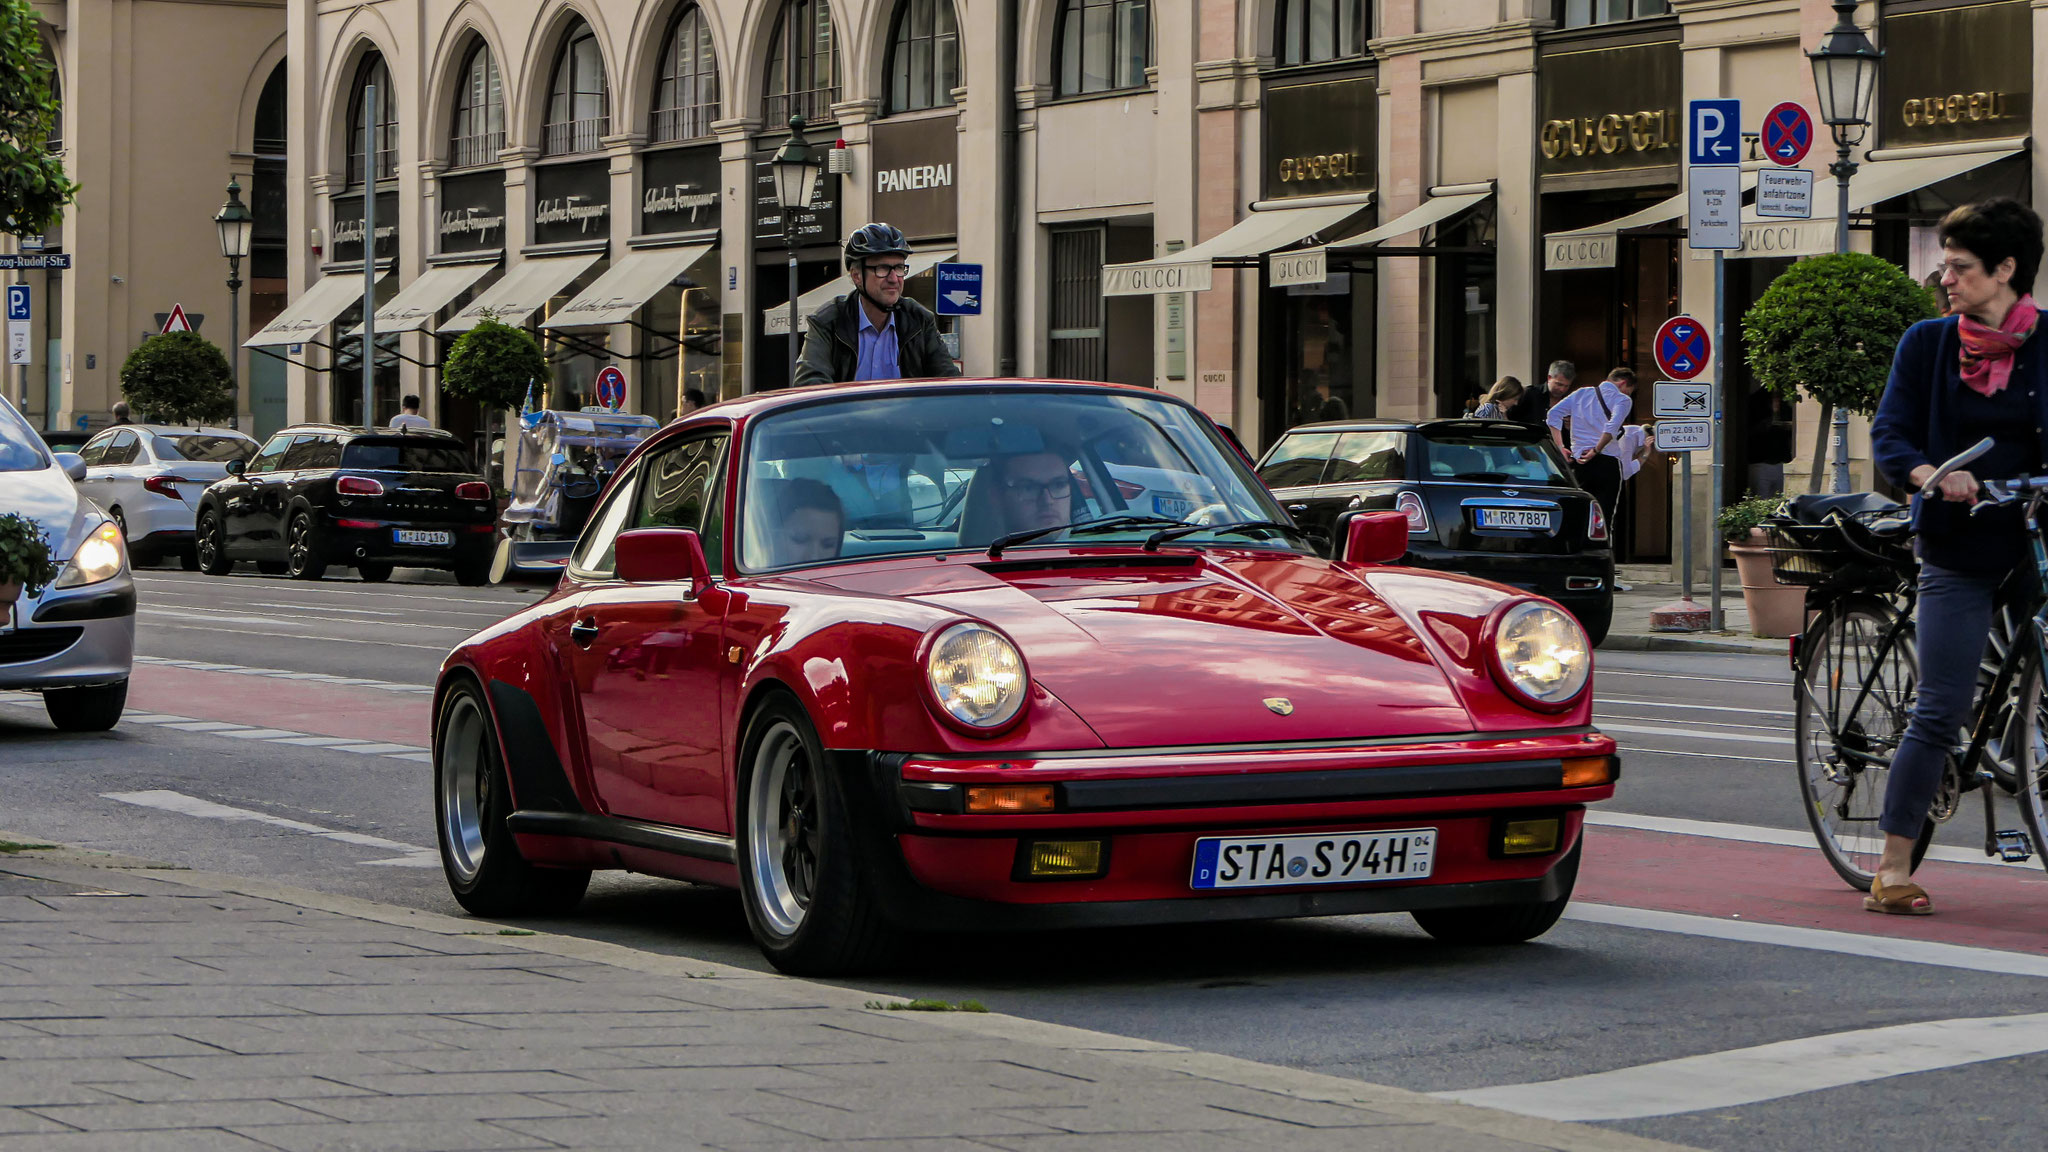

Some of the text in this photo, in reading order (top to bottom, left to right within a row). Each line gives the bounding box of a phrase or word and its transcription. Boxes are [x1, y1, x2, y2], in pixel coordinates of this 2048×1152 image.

[1903, 91, 2002, 127] GUCCI
[1541, 109, 1673, 159] GUCCI
[1697, 108, 1725, 157] P
[1280, 152, 1356, 182] GUCCI
[877, 163, 952, 193] PANERAI
[1765, 174, 1807, 186] Feuerwehr-
[1763, 189, 1805, 200] anfahrtzone
[1700, 219, 1728, 227] Parkschein
[1556, 242, 1605, 262] GUCCI
[0, 256, 67, 269] zog-Rudolf-Str.
[1278, 259, 1318, 279] GUCCI
[940, 270, 980, 282] Parkschein
[1132, 268, 1182, 289] GUCCI
[11, 290, 24, 316] P
[1203, 374, 1226, 383] GUCCI
[1484, 510, 1493, 524] M
[1414, 836, 1430, 847] 04
[1200, 869, 1209, 880] D
[1219, 843, 1286, 882] STA
[1412, 861, 1427, 873] 10
